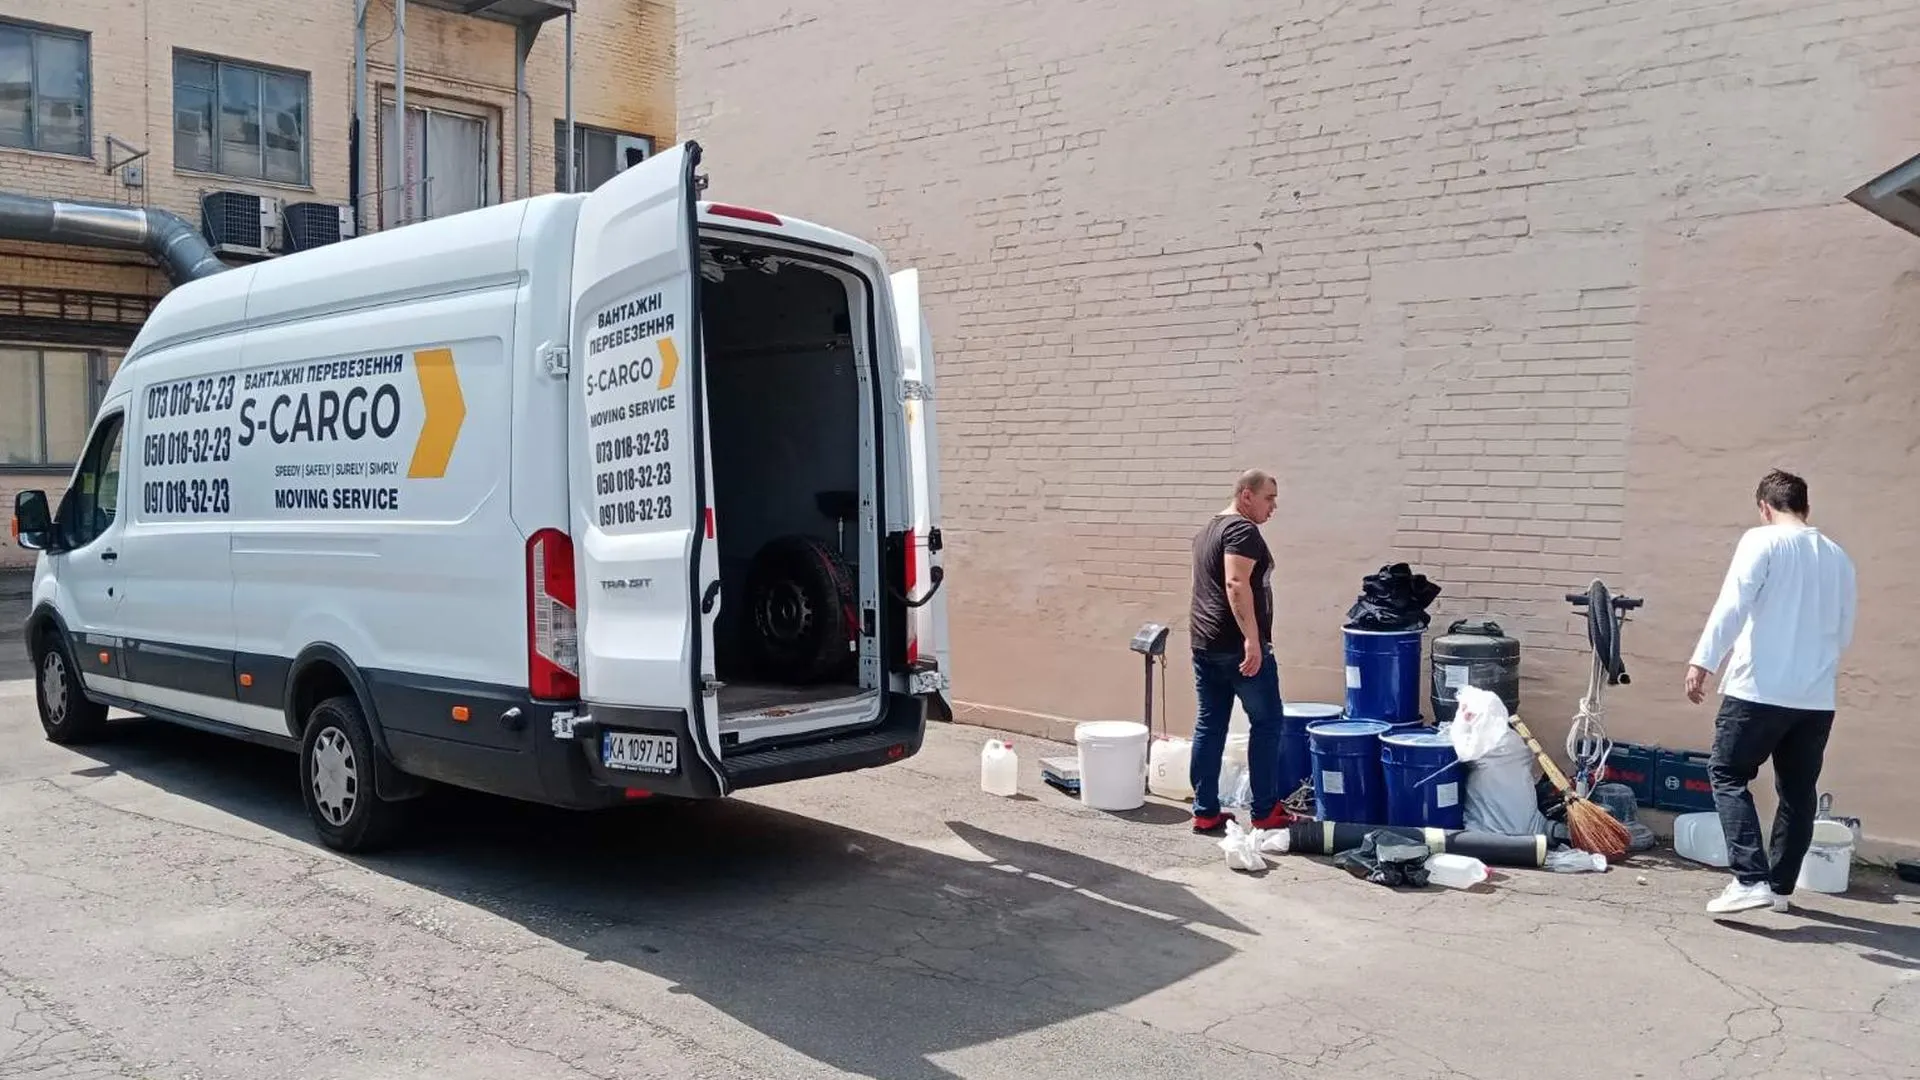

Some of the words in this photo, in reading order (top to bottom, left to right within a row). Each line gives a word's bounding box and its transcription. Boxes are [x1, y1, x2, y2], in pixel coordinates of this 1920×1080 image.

[598, 292, 662, 329] ВАНТАЖНІ
[590, 314, 674, 356] ПЕРЕВЕЗЕННЯ
[244, 367, 304, 391] ВАНТАЖНІ
[307, 354, 403, 383] ПЕРЕВЕЗЕННЯ
[587, 357, 653, 396] S-CARGO
[148, 386, 168, 419] 073
[170, 375, 235, 416] 018-32-23
[238, 383, 400, 446] S-CARGO
[590, 406, 626, 428] MOVING
[628, 394, 675, 418] SERVICE
[144, 433, 165, 467] 050
[168, 426, 231, 465] 018-32-23
[596, 440, 613, 464] 073
[614, 428, 669, 460] 018-32-23
[275, 465, 300, 477] SPEEDY
[305, 463, 331, 476] SAFELY
[336, 462, 365, 475] SURELY
[369, 461, 398, 475] SIMPLY
[597, 472, 615, 495] 050
[616, 462, 671, 492] 018-32-23
[144, 481, 163, 514] 097
[166, 478, 230, 514] 018-32-23
[275, 488, 328, 509] MOVING
[332, 488, 398, 510] SERVICE
[599, 504, 616, 527] 097
[617, 495, 672, 524] 018-32-23
[610, 737, 624, 759] KA
[629, 738, 653, 762] 1097
[656, 741, 673, 764] AB
